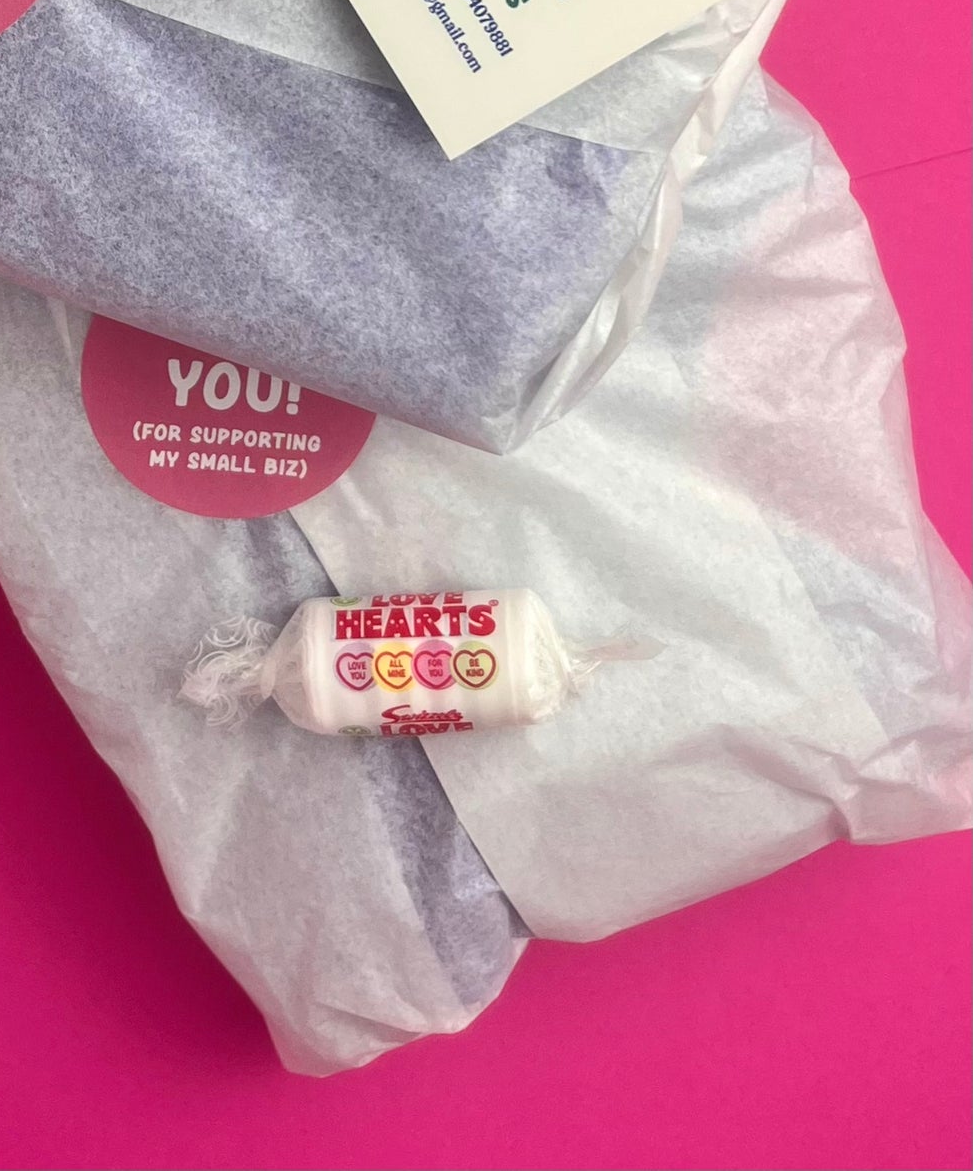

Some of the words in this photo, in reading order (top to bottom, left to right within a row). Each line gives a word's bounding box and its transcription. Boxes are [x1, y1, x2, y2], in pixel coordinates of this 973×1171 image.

[167, 359, 301, 415] YOU!
[132, 421, 181, 441] (FOR
[190, 426, 321, 452] SUPPORTING
[149, 450, 179, 467] MY
[187, 452, 256, 473] SMALL
[264, 458, 308, 479] BIZ)
[334, 604, 496, 640] HEARTS
[389, 658, 404, 668] ALL
